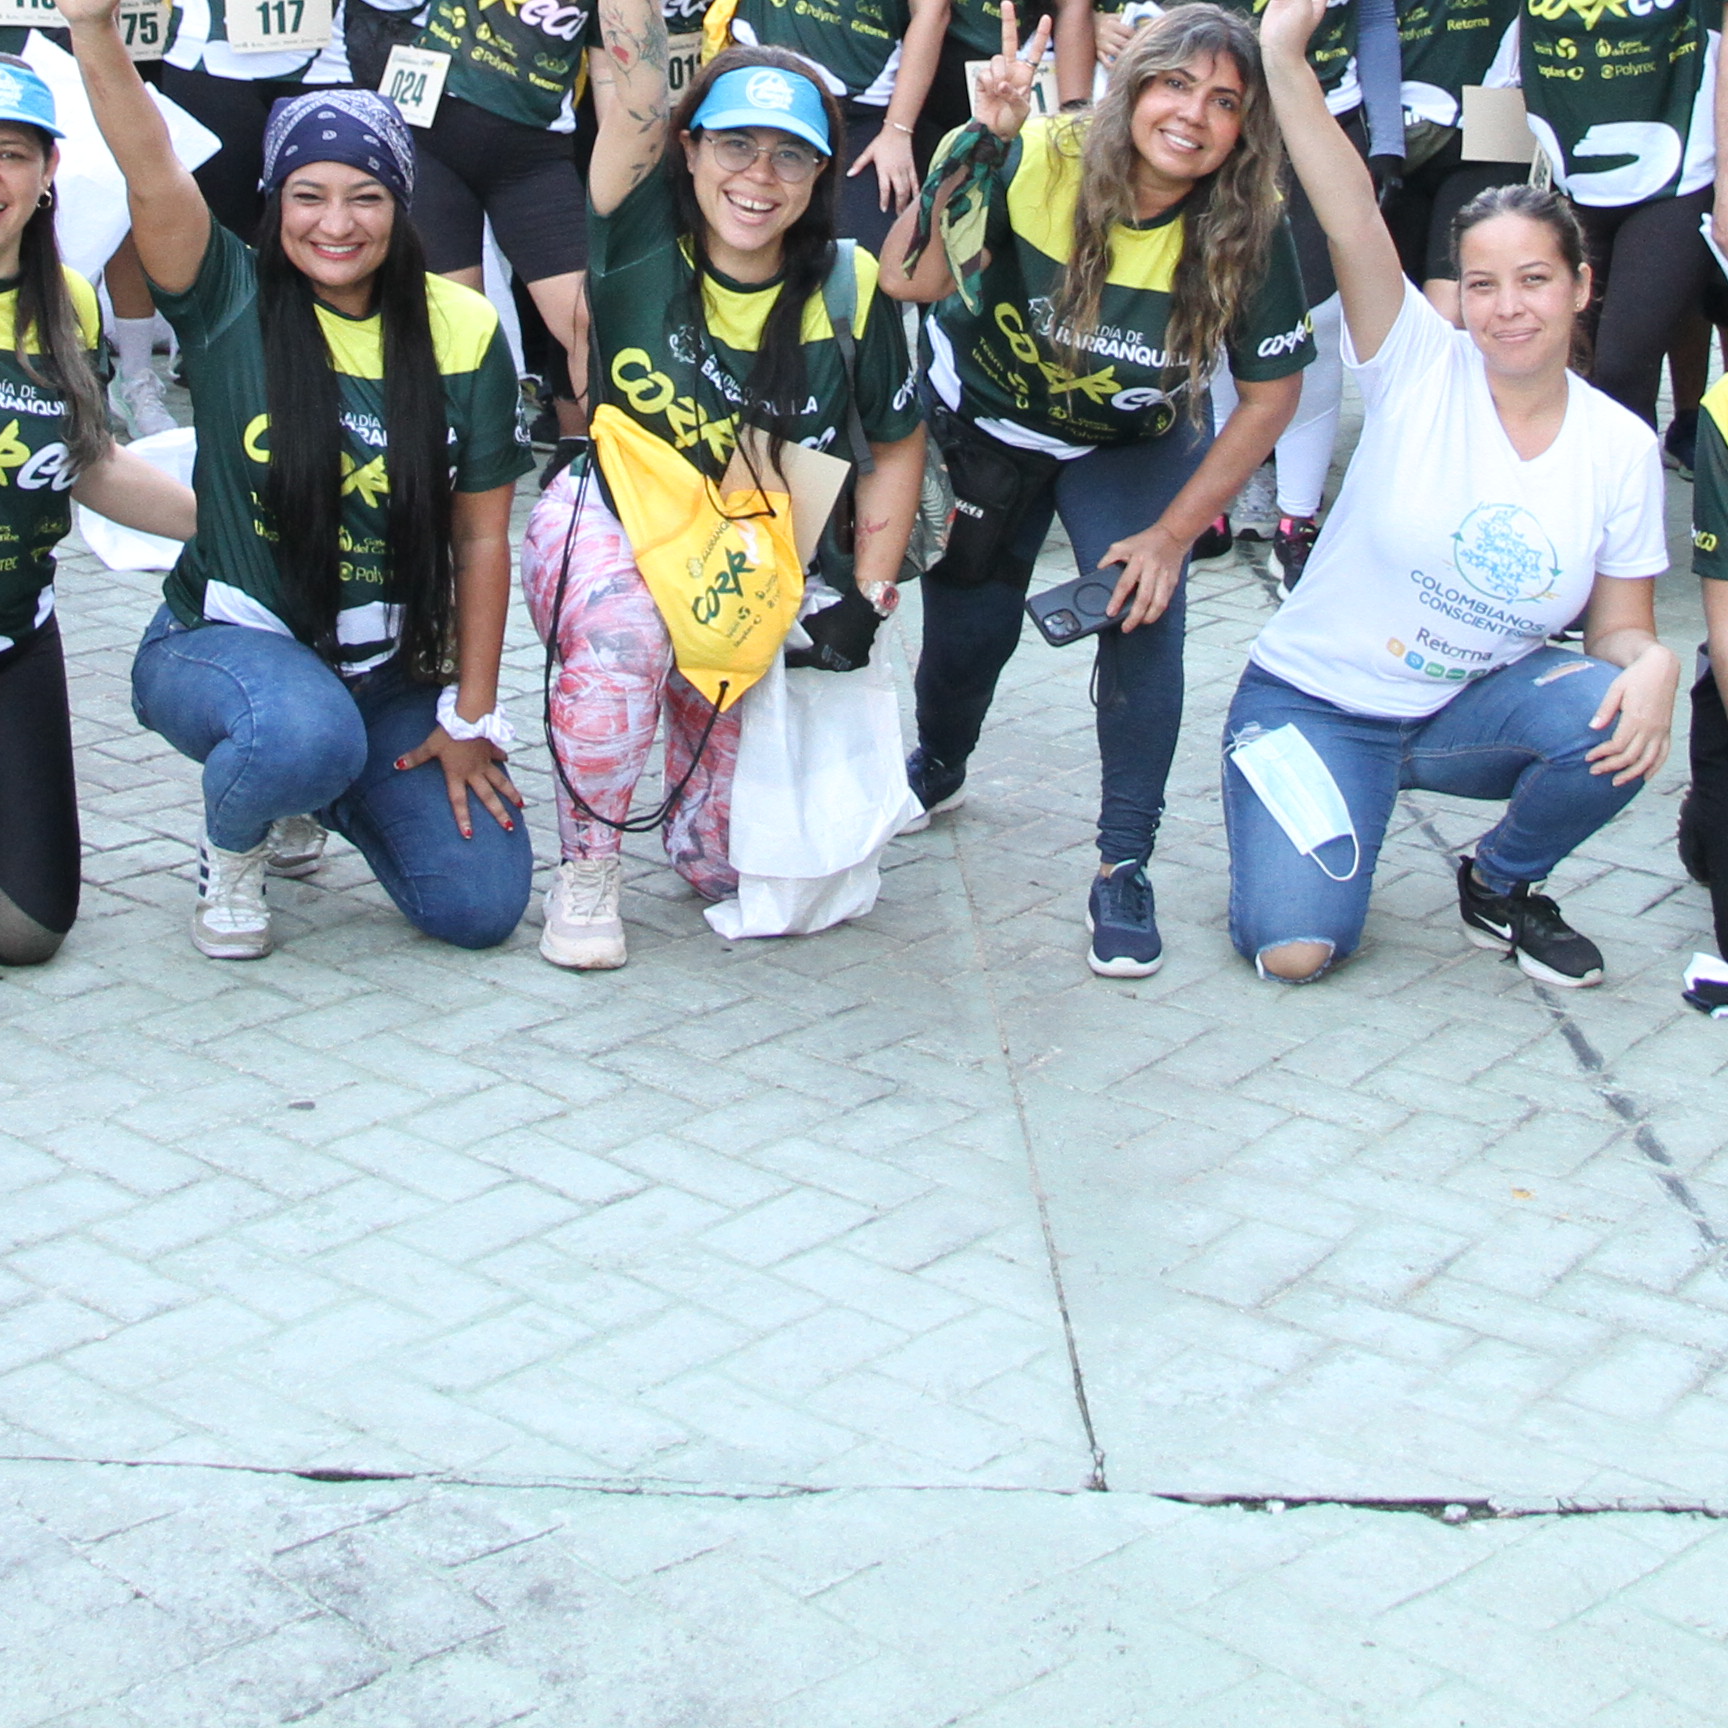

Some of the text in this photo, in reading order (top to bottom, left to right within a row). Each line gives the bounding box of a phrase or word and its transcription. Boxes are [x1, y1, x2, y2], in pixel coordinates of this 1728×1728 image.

[121, 12, 159, 45] 75
[256, 0, 306, 35] 117
[1446, 16, 1490, 32] Retorna
[1615, 61, 1657, 77] Polyrec
[391, 69, 428, 107] 024
[1128, 329, 1145, 345] DE
[20, 384, 38, 400] DE
[1410, 569, 1547, 634] COLOMBIANOS
[1416, 626, 1493, 663] Retorna
